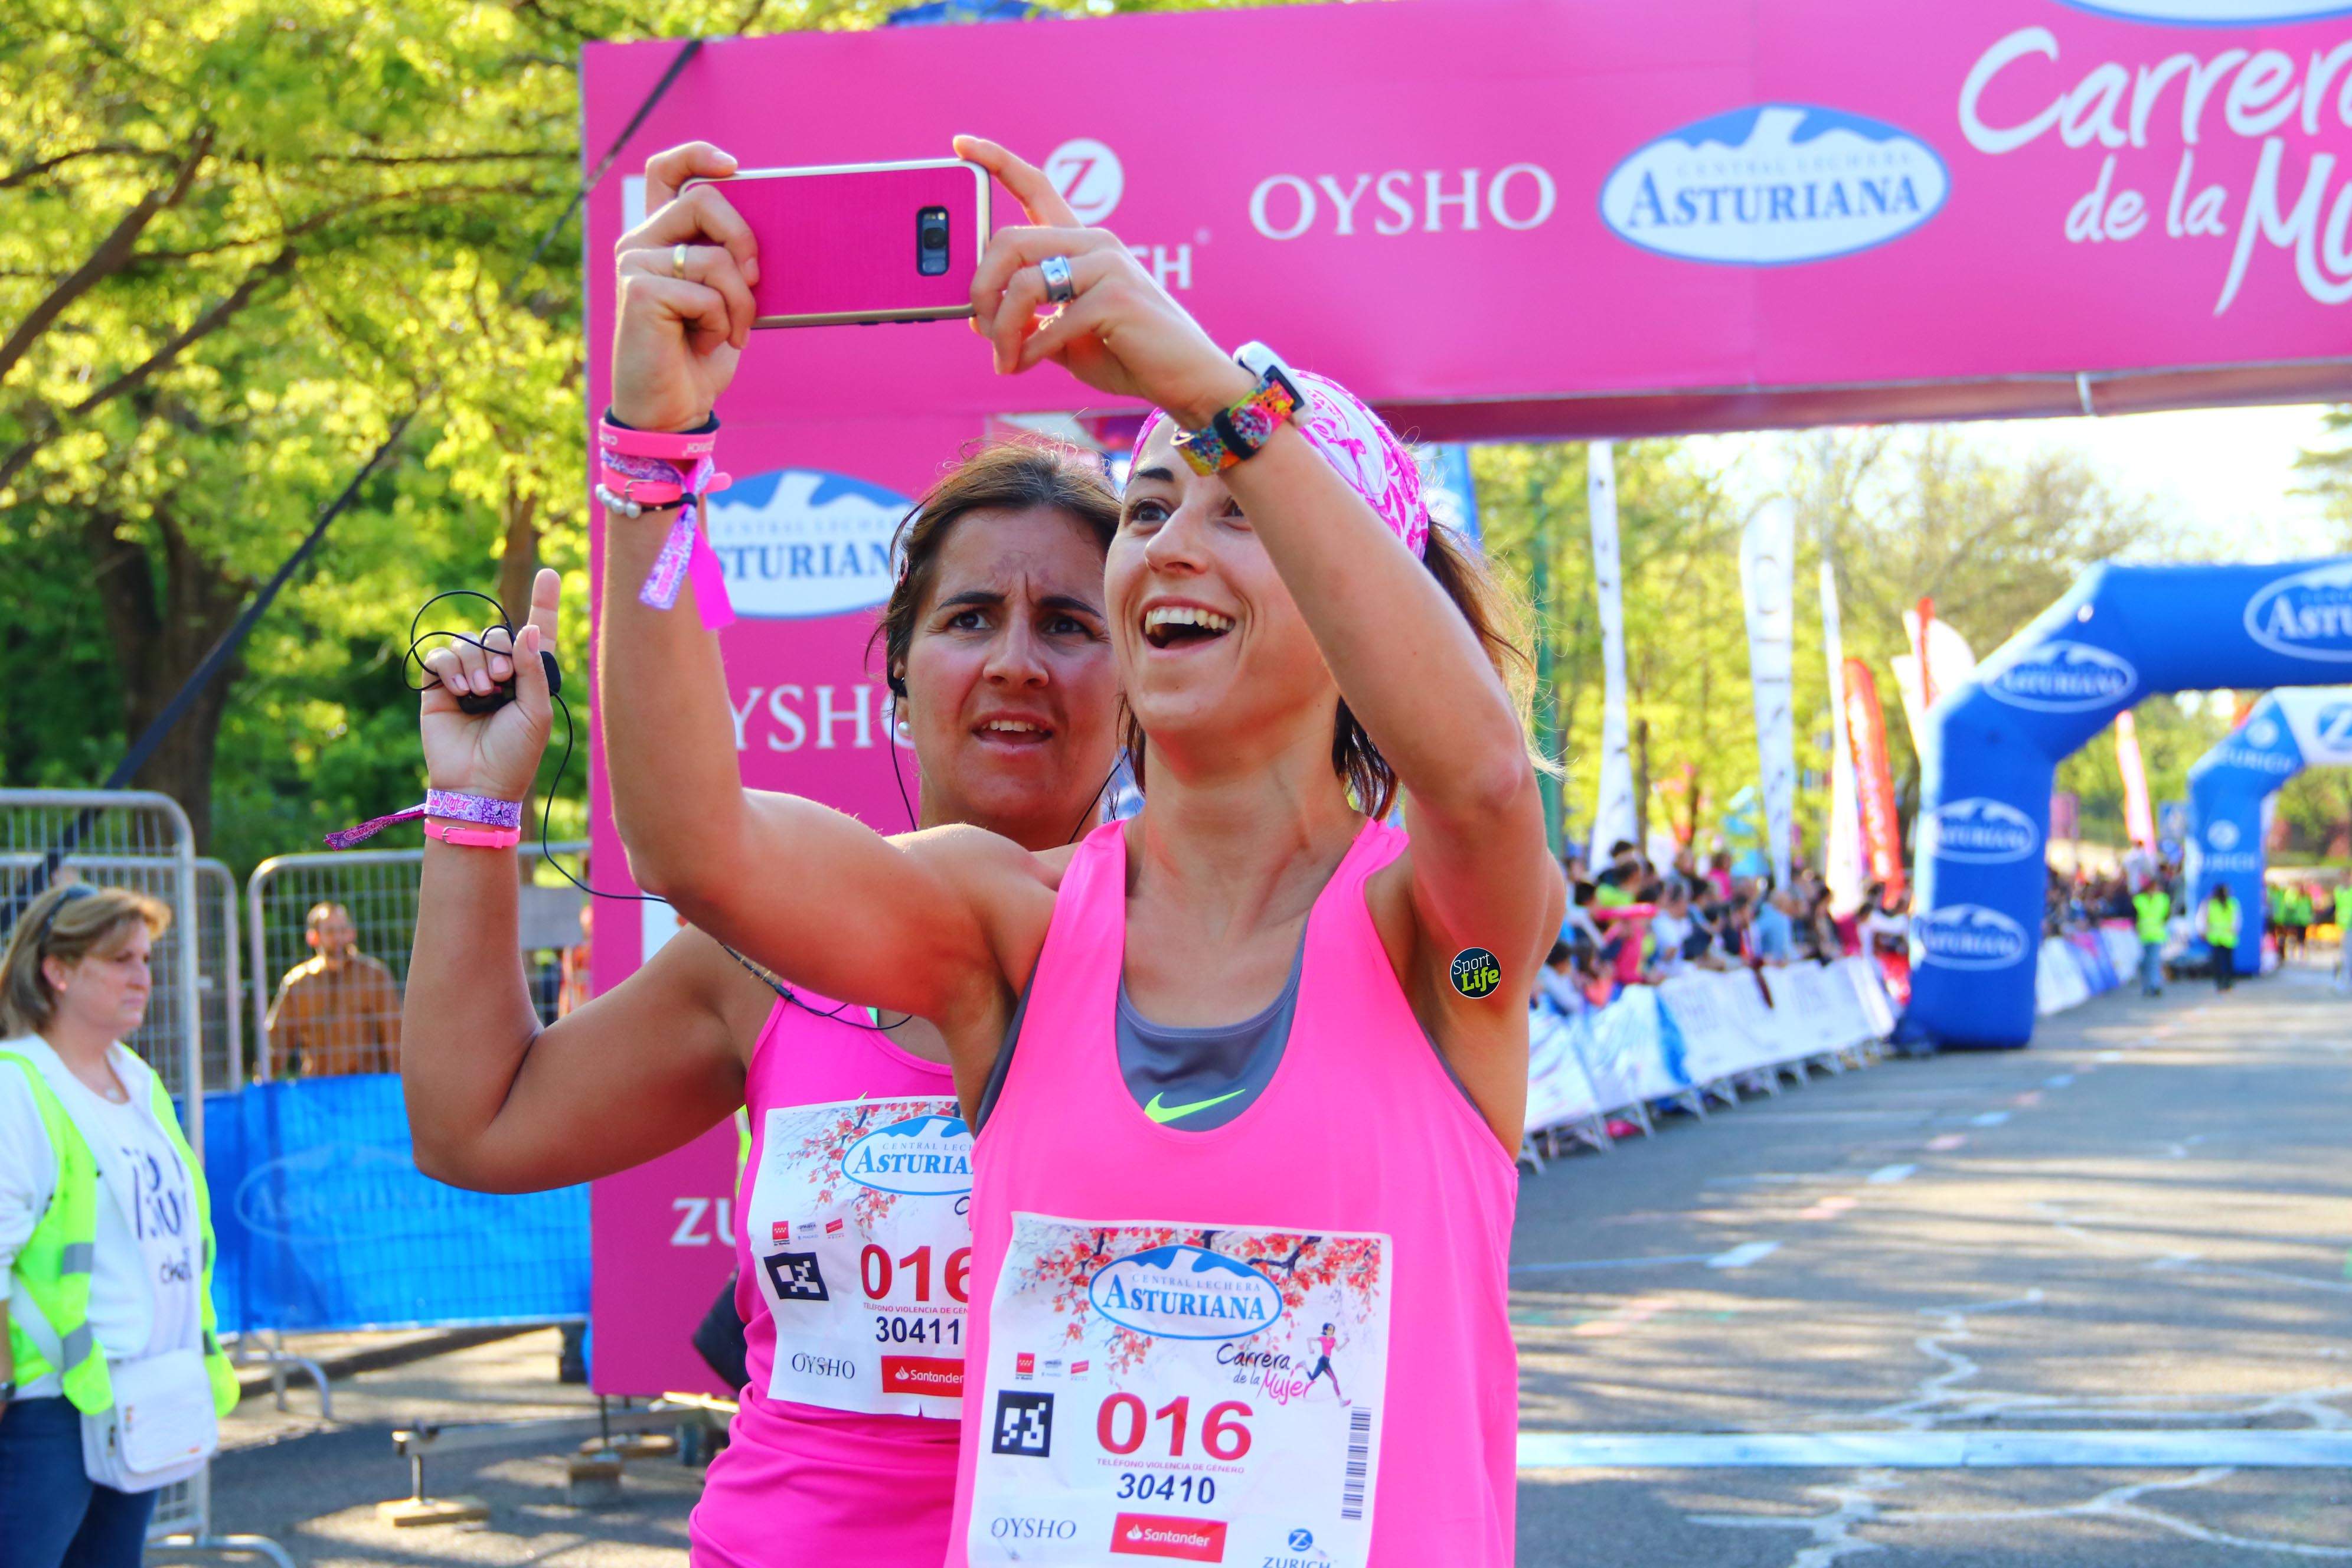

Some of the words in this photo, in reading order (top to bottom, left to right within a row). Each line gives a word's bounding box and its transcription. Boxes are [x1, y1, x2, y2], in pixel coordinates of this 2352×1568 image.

[1958, 26, 2352, 155] Carrer
[1249, 163, 1556, 240] OYSHO
[1627, 171, 1922, 228] ASTURIANA
[2064, 152, 2149, 243] de
[2166, 148, 2227, 238] la
[714, 541, 893, 580] TURIAN
[730, 684, 917, 753] YSH
[852, 1145, 973, 1174] ASTURIA
[882, 1142, 940, 1151] CENTRAL
[861, 1243, 972, 1304] 016
[1132, 1274, 1191, 1288] CENTRAL
[1197, 1280, 1261, 1292] LECHERA
[1102, 1273, 1266, 1321] ASTURIANA
[876, 1316, 959, 1345] 30411
[792, 1353, 855, 1379] OYSHO
[1216, 1342, 1291, 1370] Carrera
[910, 1369, 964, 1384] Santander
[1233, 1368, 1247, 1384] de
[1249, 1368, 1261, 1385] la
[1256, 1368, 1317, 1406] Mujer
[1096, 1391, 1253, 1462] 016
[1097, 1458, 1144, 1468] TELÉFONO
[1146, 1461, 1190, 1471] VIOLENCIA
[1193, 1463, 1204, 1471] DE
[1206, 1462, 1245, 1474] GÉNERO
[1116, 1472, 1215, 1504] 30410
[991, 1517, 1077, 1540] OYSHO
[1143, 1527, 1210, 1548] Santander
